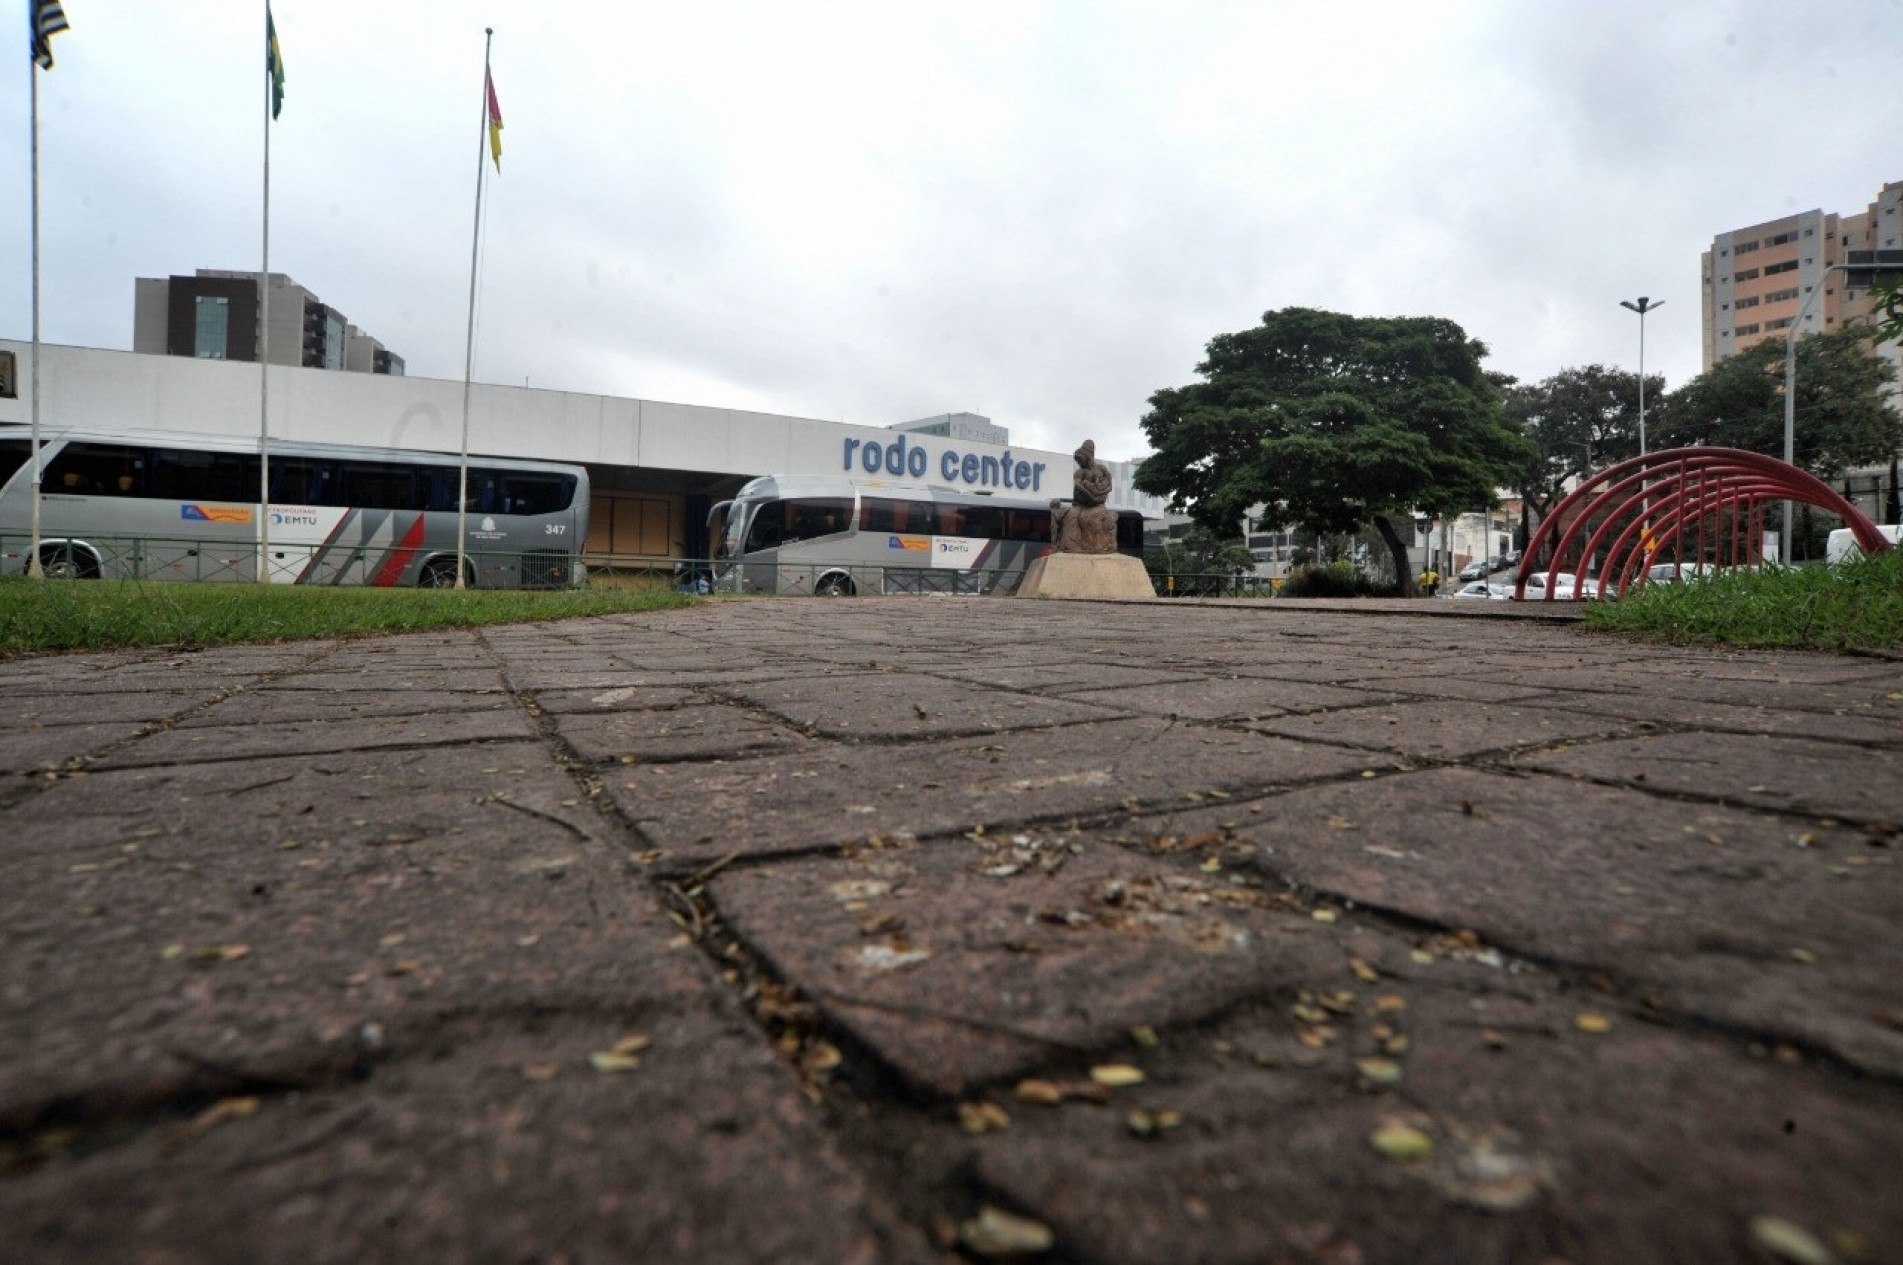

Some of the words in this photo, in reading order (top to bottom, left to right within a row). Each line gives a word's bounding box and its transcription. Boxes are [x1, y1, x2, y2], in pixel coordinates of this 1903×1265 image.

[843, 434, 927, 477] rodo
[940, 450, 1046, 491] center
[284, 516, 318, 525] EMTU
[545, 524, 566, 535] 347
